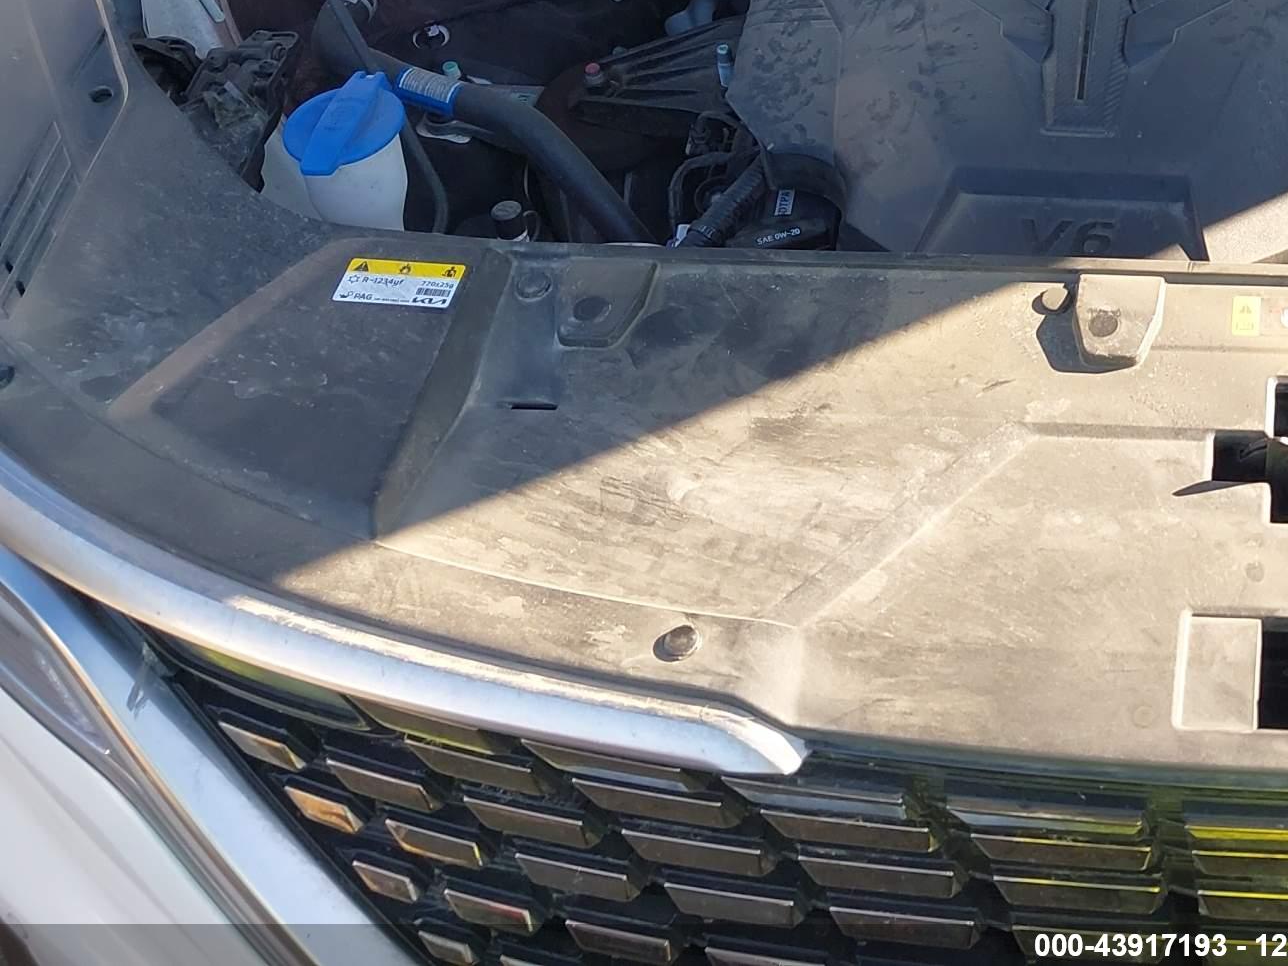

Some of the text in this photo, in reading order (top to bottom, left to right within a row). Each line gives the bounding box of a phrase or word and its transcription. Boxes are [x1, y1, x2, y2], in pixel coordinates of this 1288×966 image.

[756, 234, 775, 246] SAE
[1021, 218, 1116, 255] V6
[361, 276, 404, 288] R-1234yf
[353, 292, 373, 300] PAG
